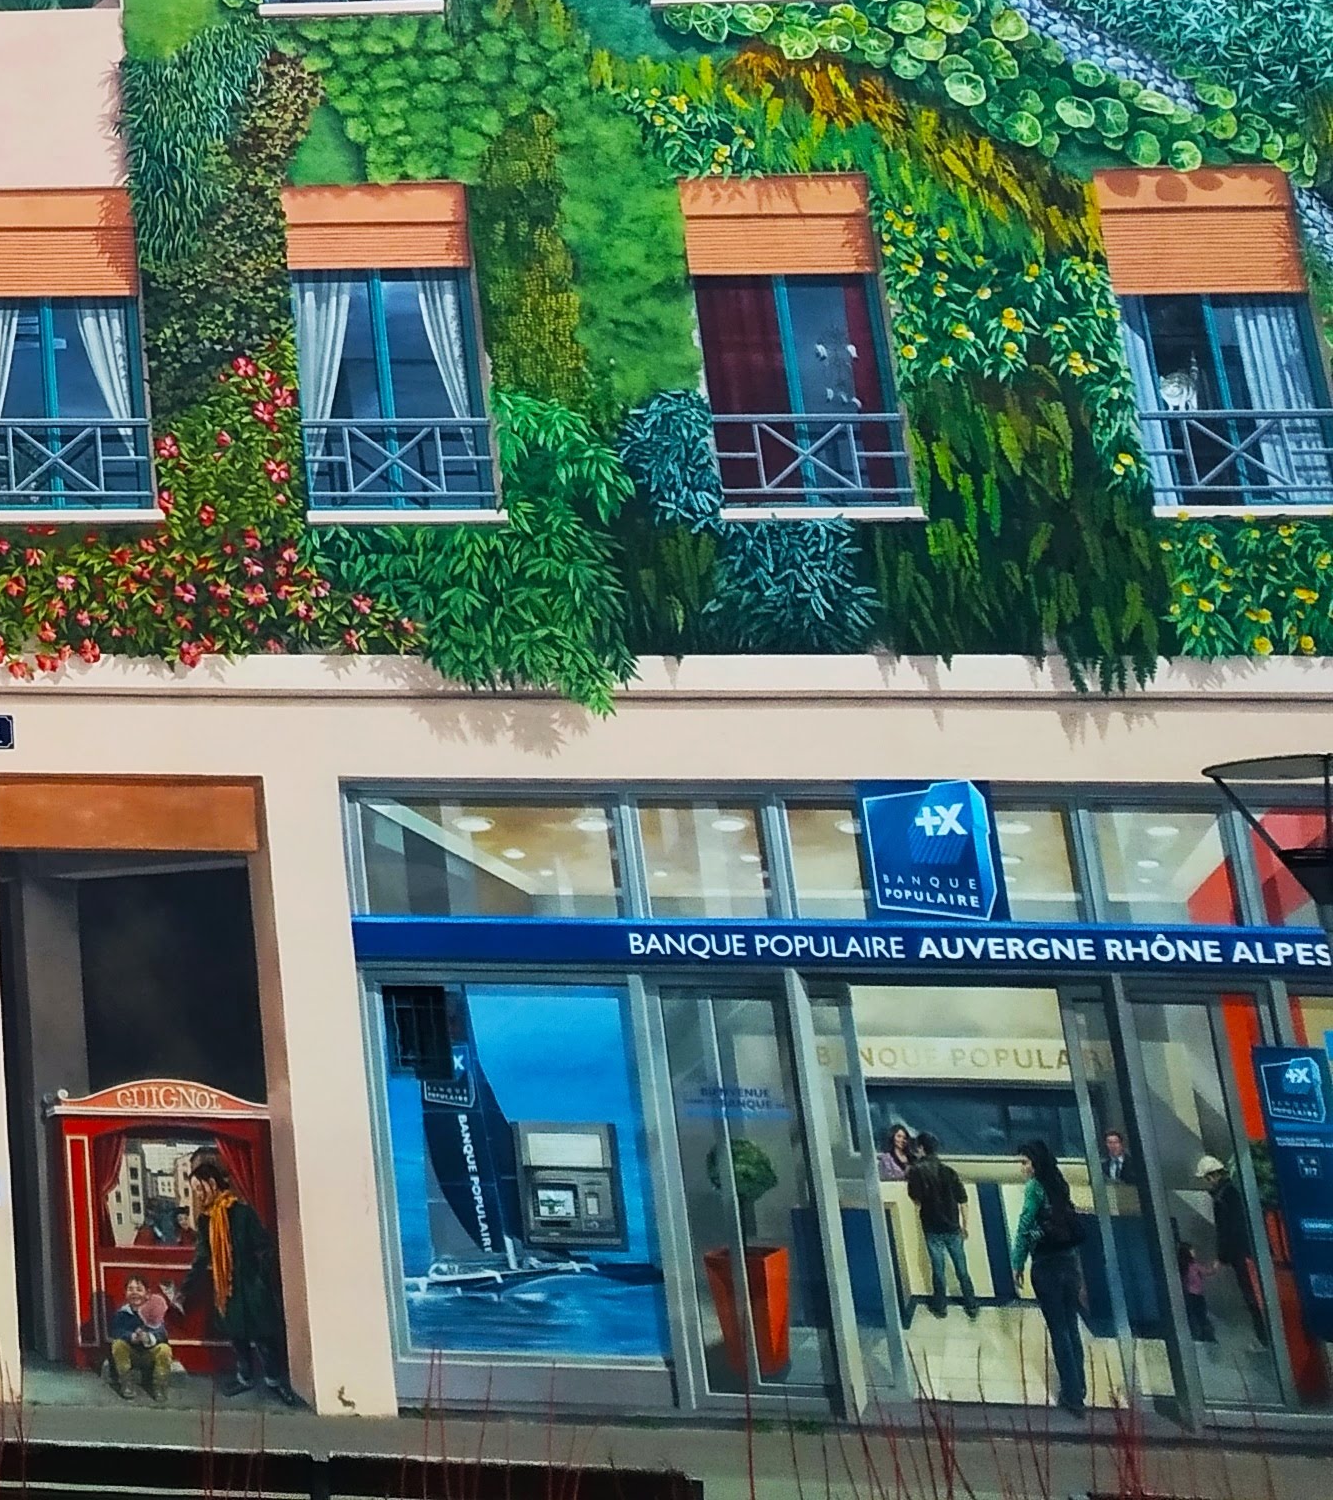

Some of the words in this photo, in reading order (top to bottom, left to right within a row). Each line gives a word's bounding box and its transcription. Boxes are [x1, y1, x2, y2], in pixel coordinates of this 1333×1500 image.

[883, 874, 978, 890] BANQUE
[884, 888, 981, 908] POPULAIRE
[628, 933, 745, 959] BANQUE
[754, 934, 906, 959] POPULAIRE
[918, 937, 1097, 961] AUVERGNE
[1103, 934, 1224, 963] RHÔNE
[1231, 941, 1332, 967] ALPES
[116, 1086, 221, 1109] GUIGNOL
[458, 1113, 478, 1173] BANQUE
